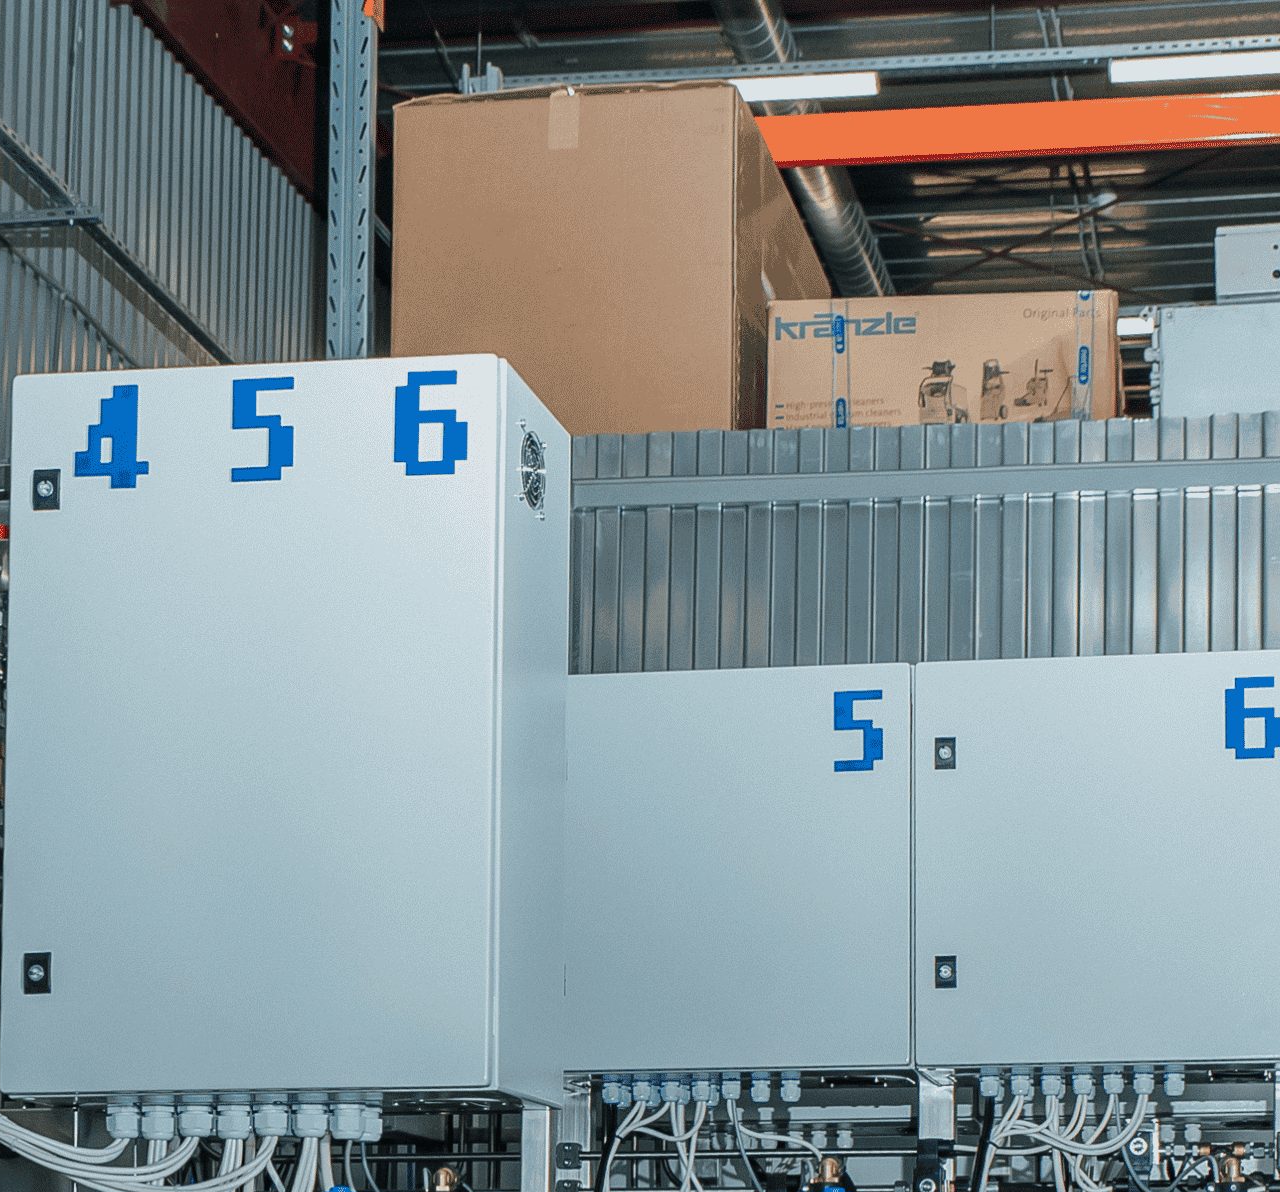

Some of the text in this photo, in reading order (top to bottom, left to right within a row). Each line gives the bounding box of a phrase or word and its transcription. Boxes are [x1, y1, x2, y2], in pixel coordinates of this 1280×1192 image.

[1023, 308, 1069, 321] Original
[75, 370, 467, 488] 4 5 6
[865, 407, 902, 417] cleaners
[834, 690, 883, 772] 5
[1225, 676, 1280, 759] 6
